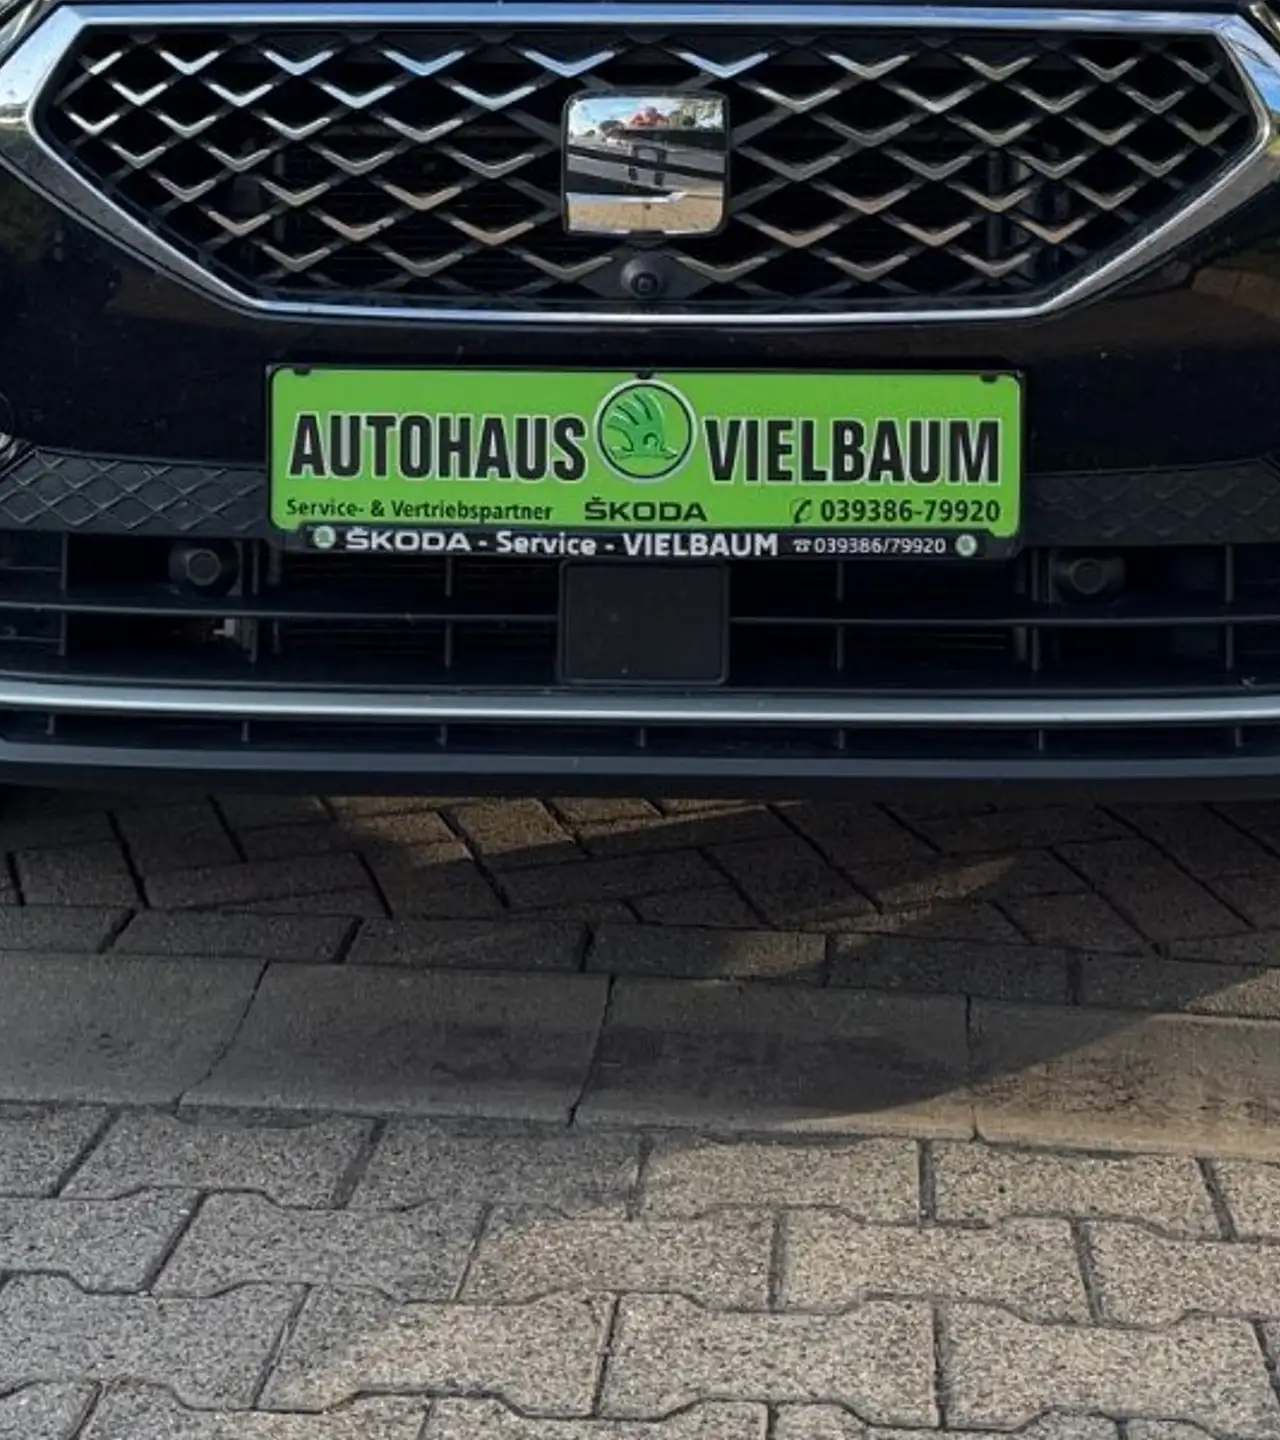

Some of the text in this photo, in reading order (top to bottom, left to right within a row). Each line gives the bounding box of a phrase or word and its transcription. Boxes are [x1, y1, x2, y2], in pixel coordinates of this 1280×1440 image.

[288, 413, 1001, 485] AUTOHAUS VIELBAUM
[286, 497, 1001, 523] Service- & Vertriebspartner ŠKODA 039386-79920
[345, 526, 471, 551] ŠKODA
[496, 530, 597, 555] Service
[623, 532, 778, 557] VIELBAUM
[814, 537, 946, 554] 039386/79920
